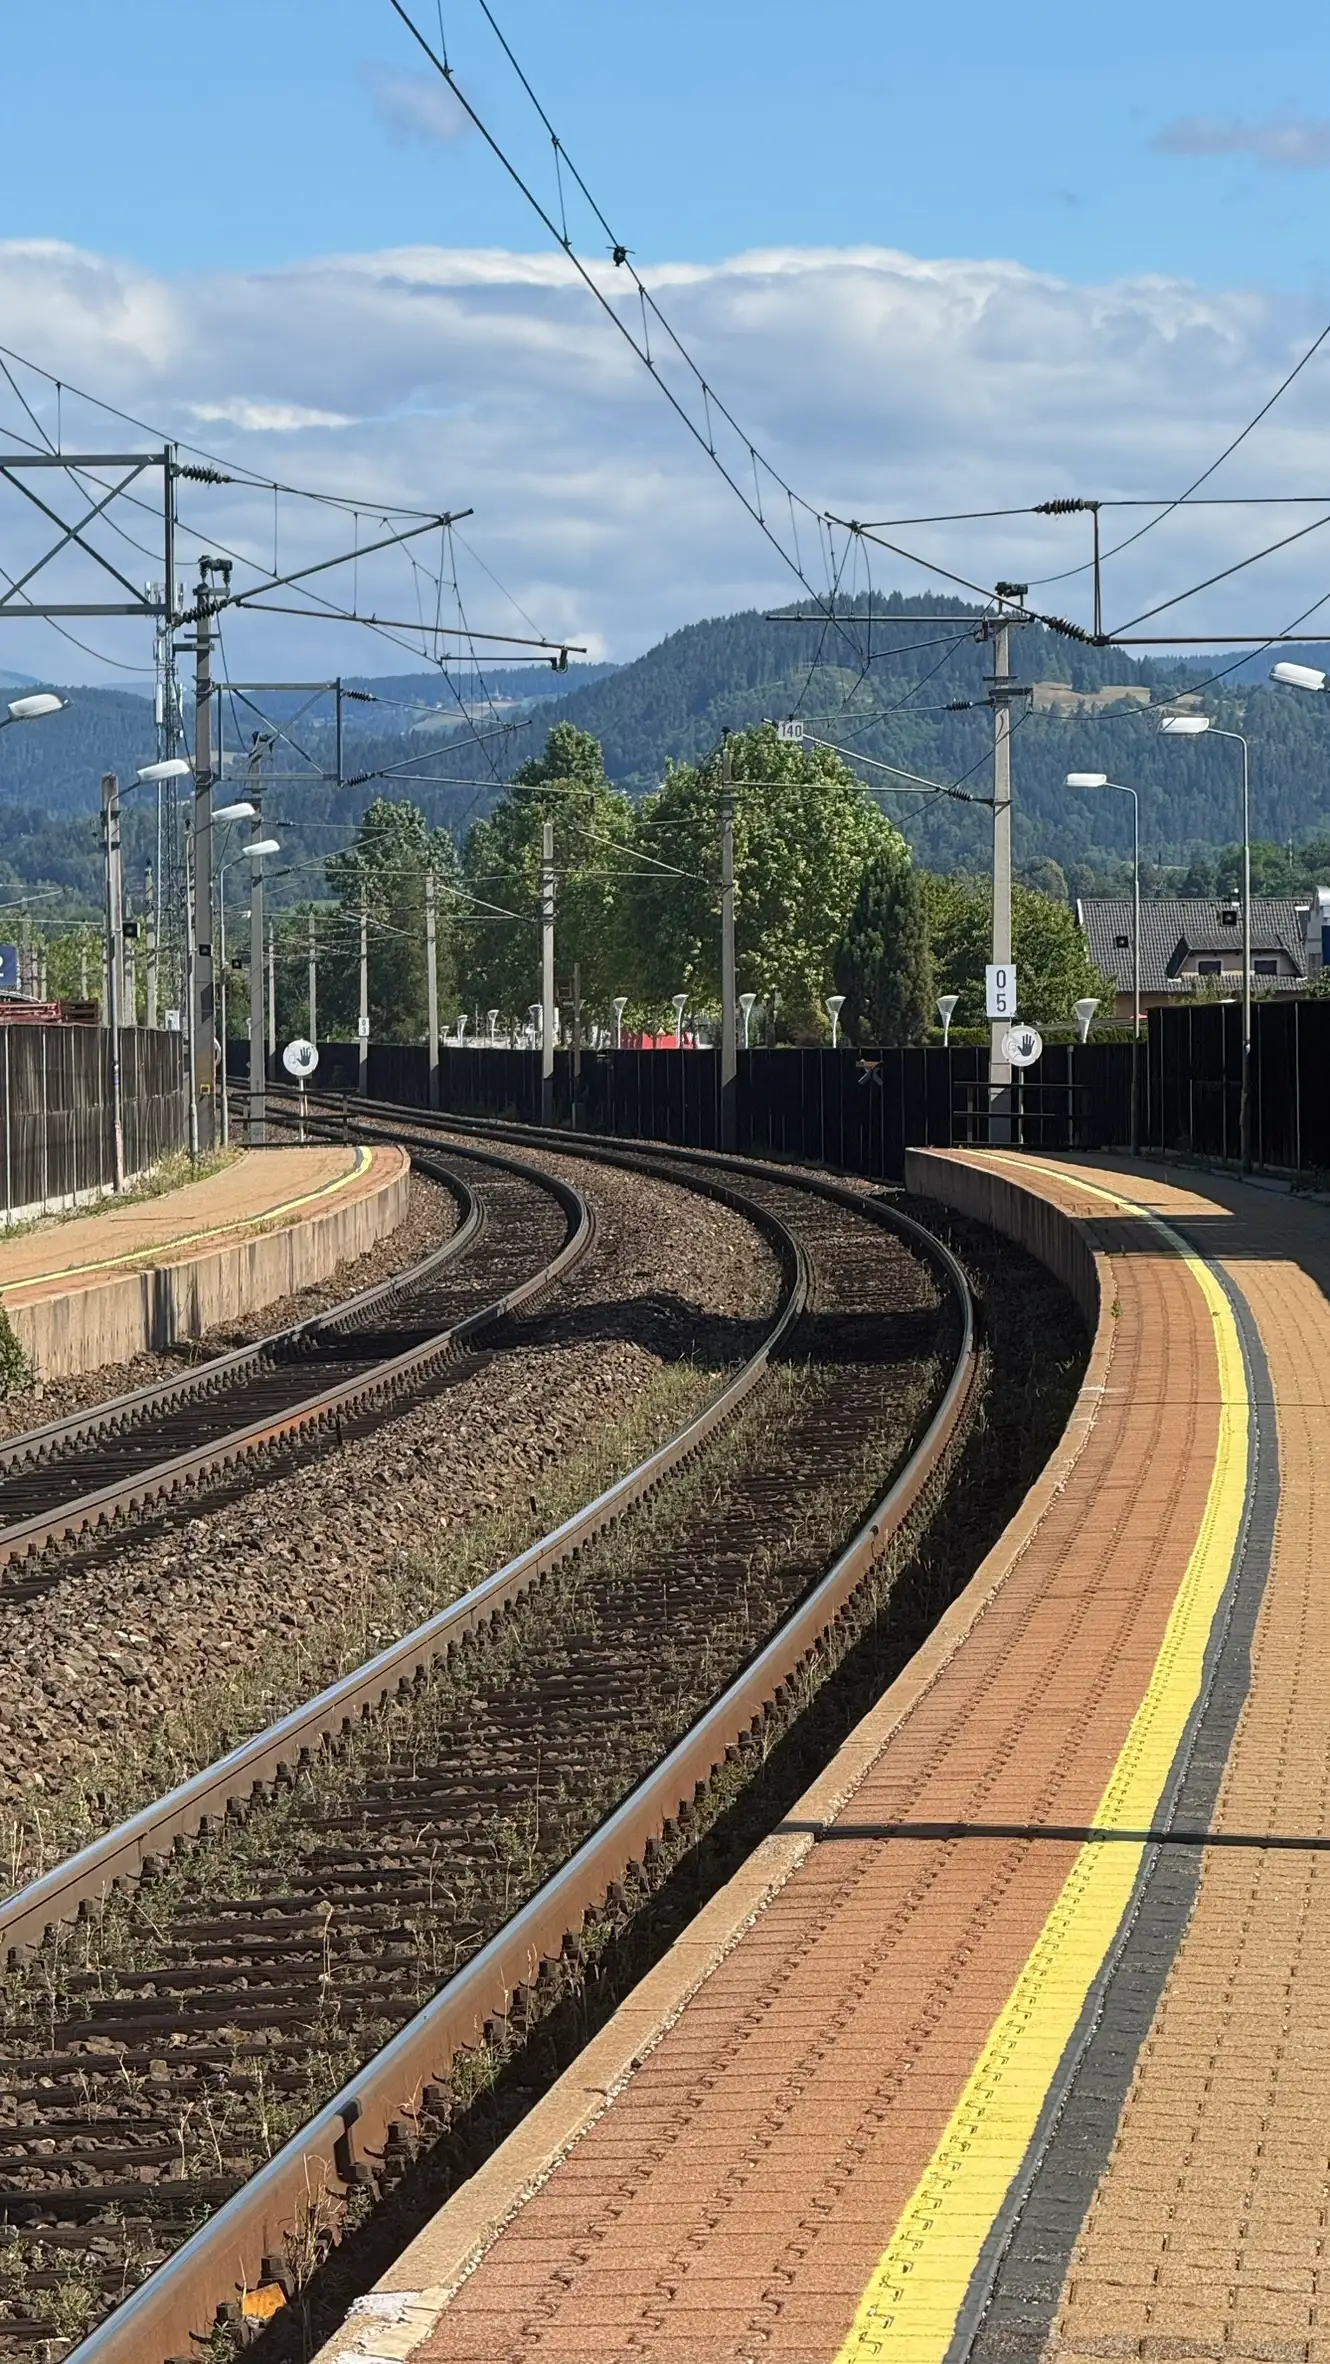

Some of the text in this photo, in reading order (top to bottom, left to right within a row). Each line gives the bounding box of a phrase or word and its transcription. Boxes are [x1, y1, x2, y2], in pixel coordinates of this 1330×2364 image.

[782, 724, 802, 737] 140
[996, 969, 1006, 988] 0
[996, 994, 1006, 1012] 5
